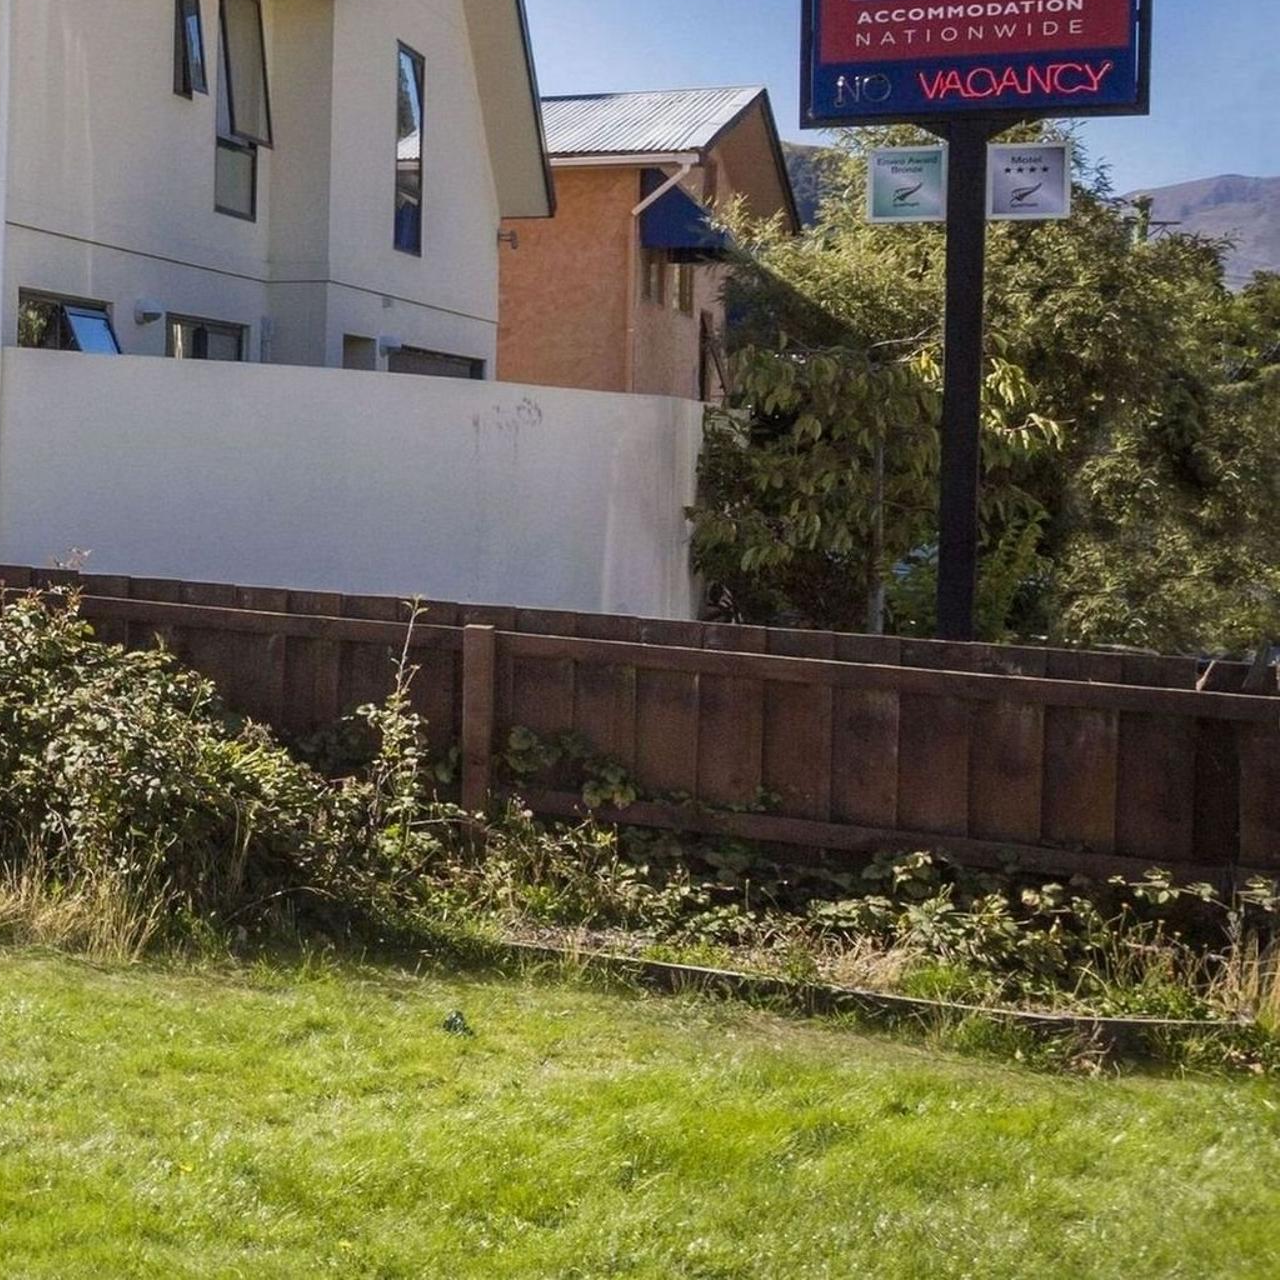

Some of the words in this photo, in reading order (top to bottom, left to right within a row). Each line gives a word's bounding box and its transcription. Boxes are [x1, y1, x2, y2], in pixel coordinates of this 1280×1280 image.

[855, 19, 1083, 47] NATIONWIDE
[834, 73, 892, 107] NO
[919, 62, 1112, 99] VACANCY
